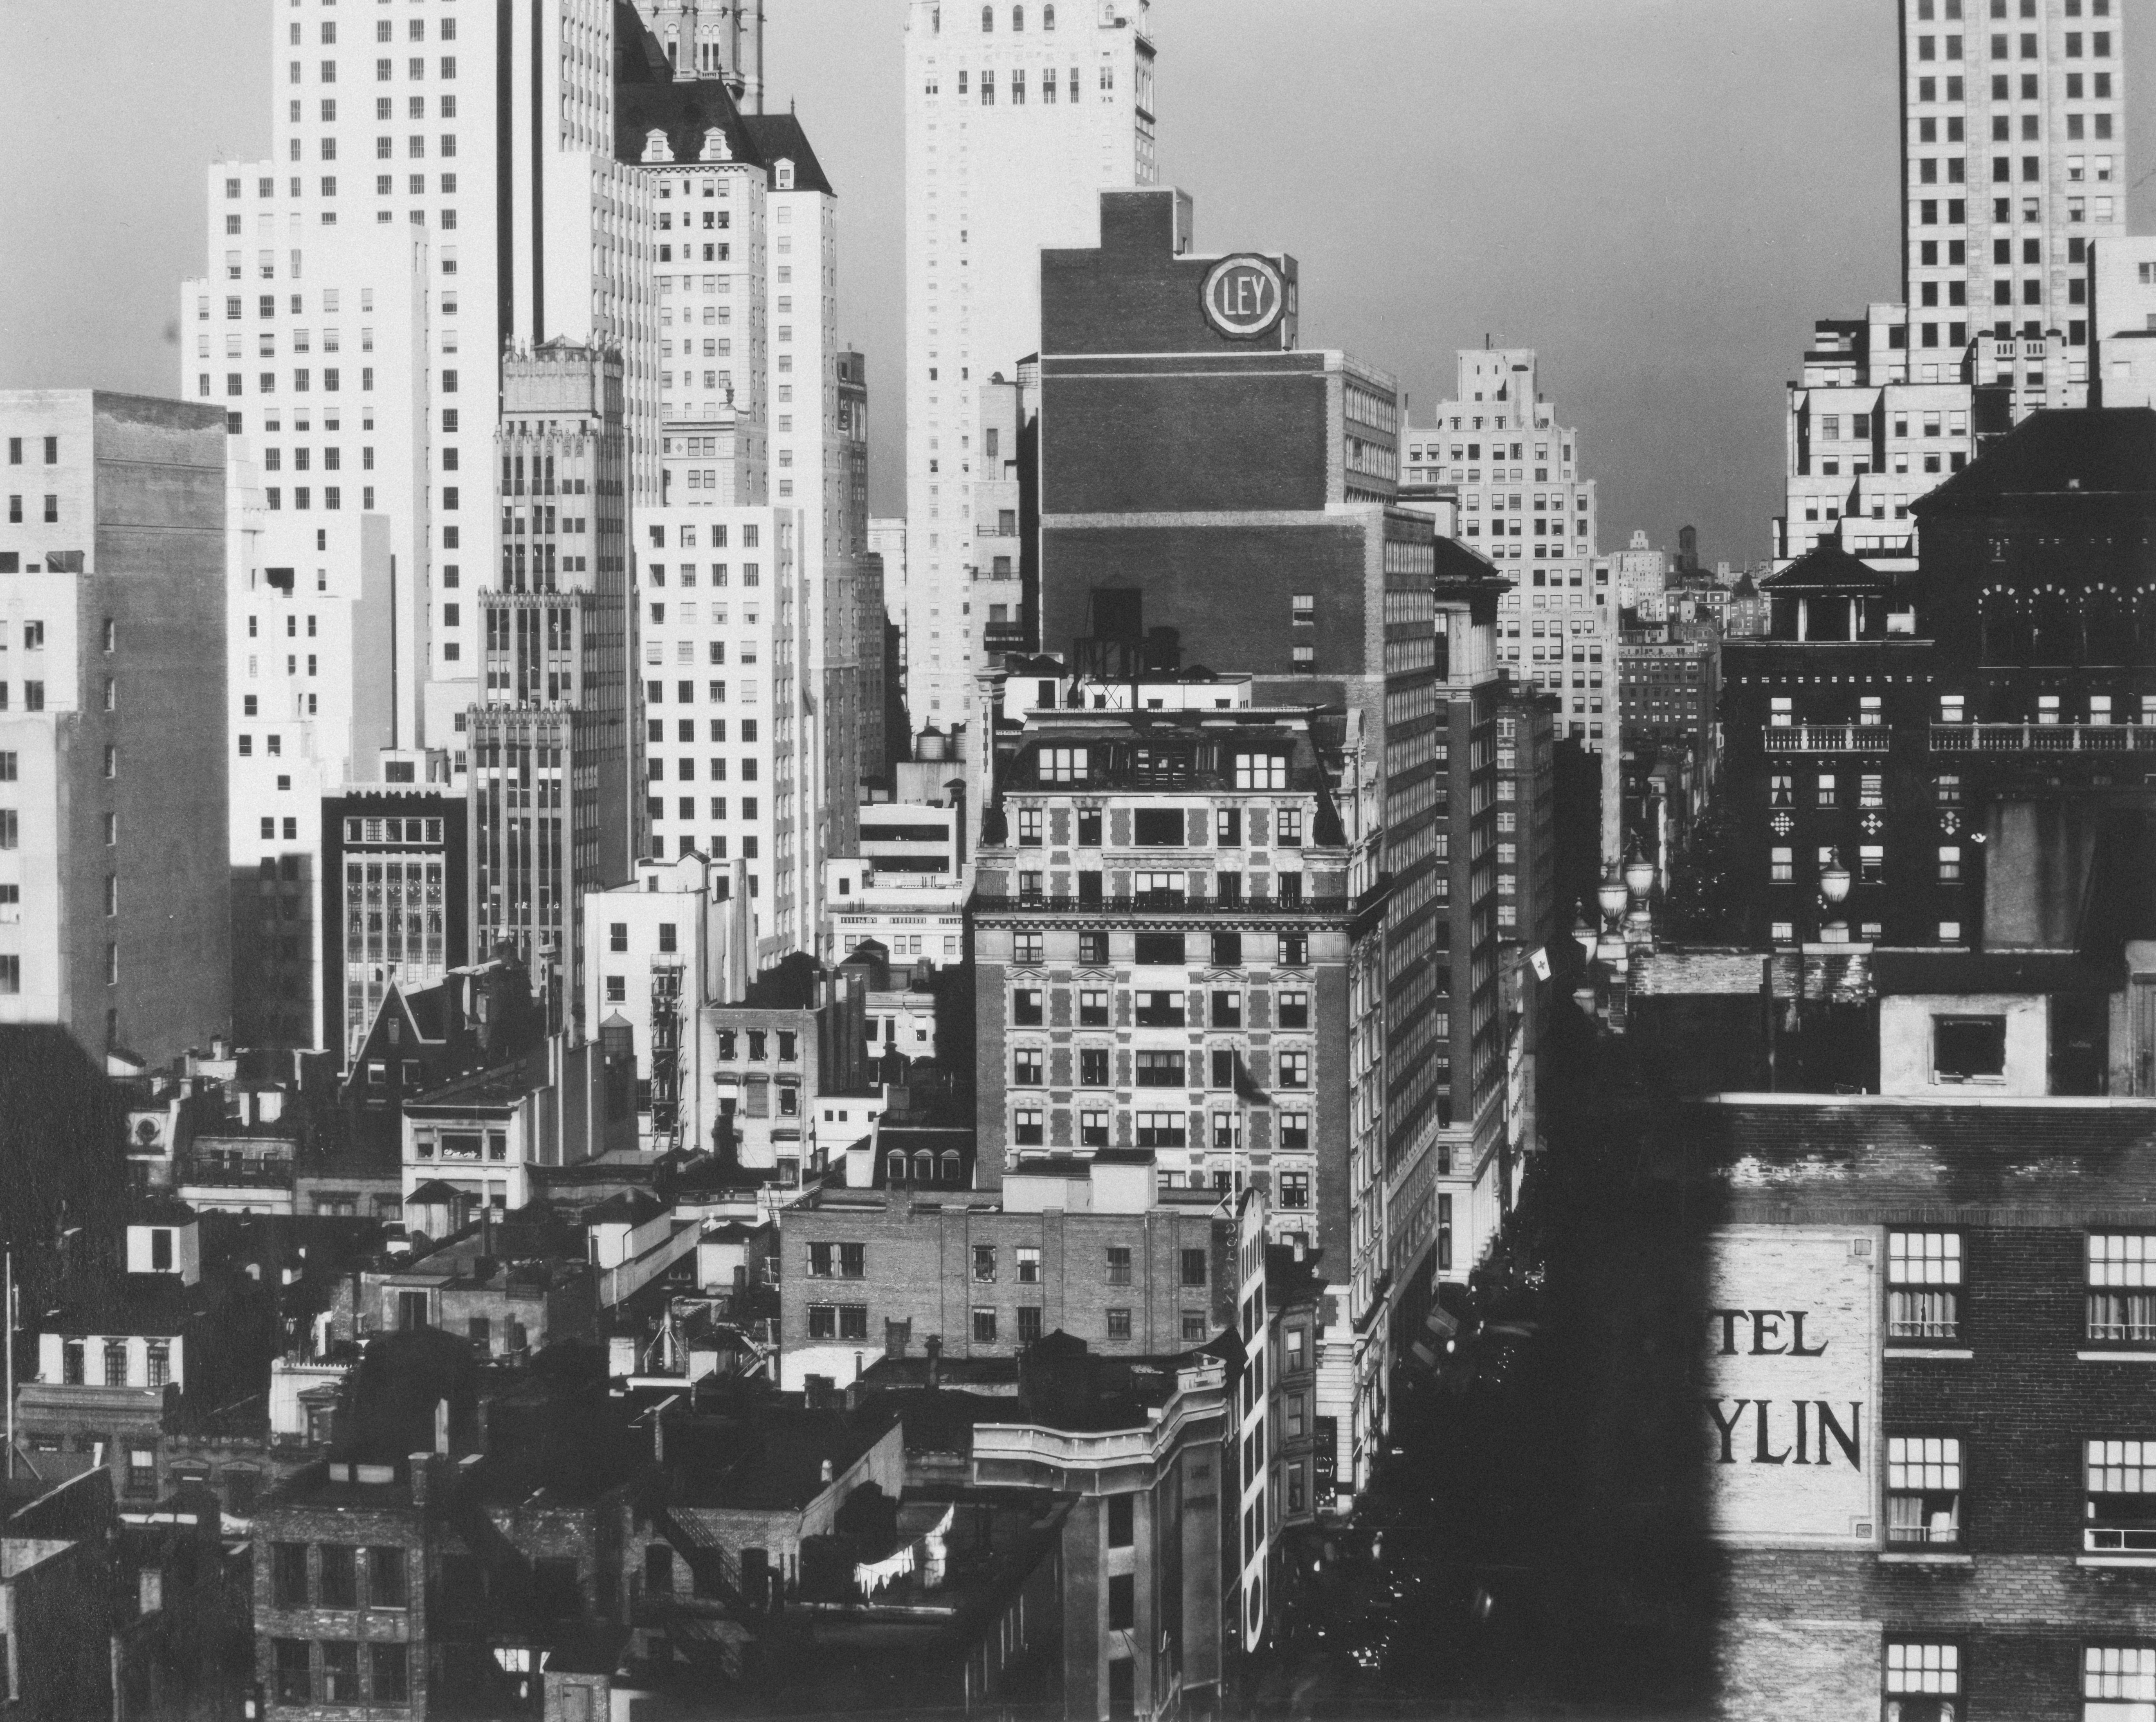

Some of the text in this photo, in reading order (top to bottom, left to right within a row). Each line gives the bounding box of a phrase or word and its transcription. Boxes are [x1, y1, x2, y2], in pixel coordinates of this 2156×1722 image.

[1224, 275, 1265, 315] LEY
[1709, 1309, 1829, 1357] TEL
[1703, 1399, 1864, 1472] YLIN
